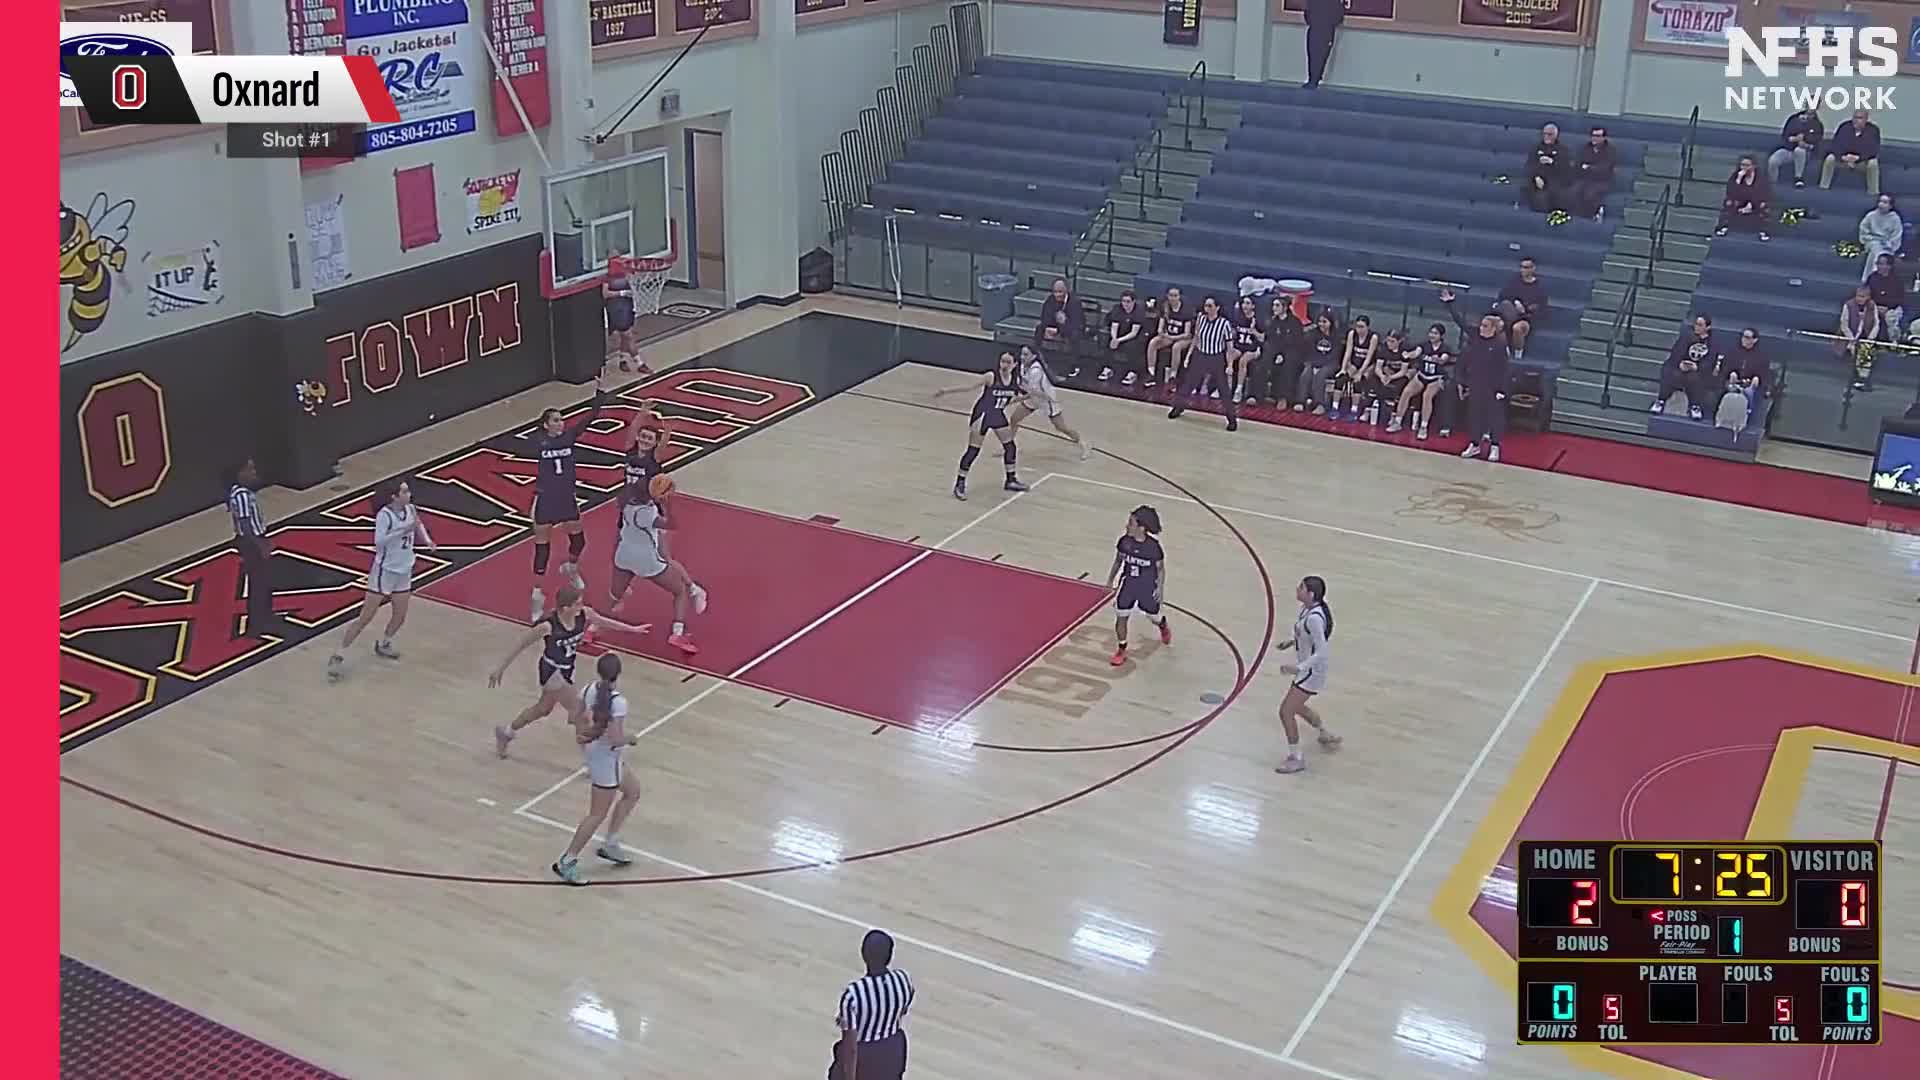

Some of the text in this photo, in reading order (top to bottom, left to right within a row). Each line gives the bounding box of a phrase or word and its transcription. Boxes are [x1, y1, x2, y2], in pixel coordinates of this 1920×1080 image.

[393, 10, 420, 26] INC.
[1662, 7, 1725, 33] TORAZO
[357, 31, 457, 56] Go Jackets!
[371, 118, 458, 148] 805-804-7205
[155, 267, 194, 289] IT UP
[554, 459, 564, 475] 1
